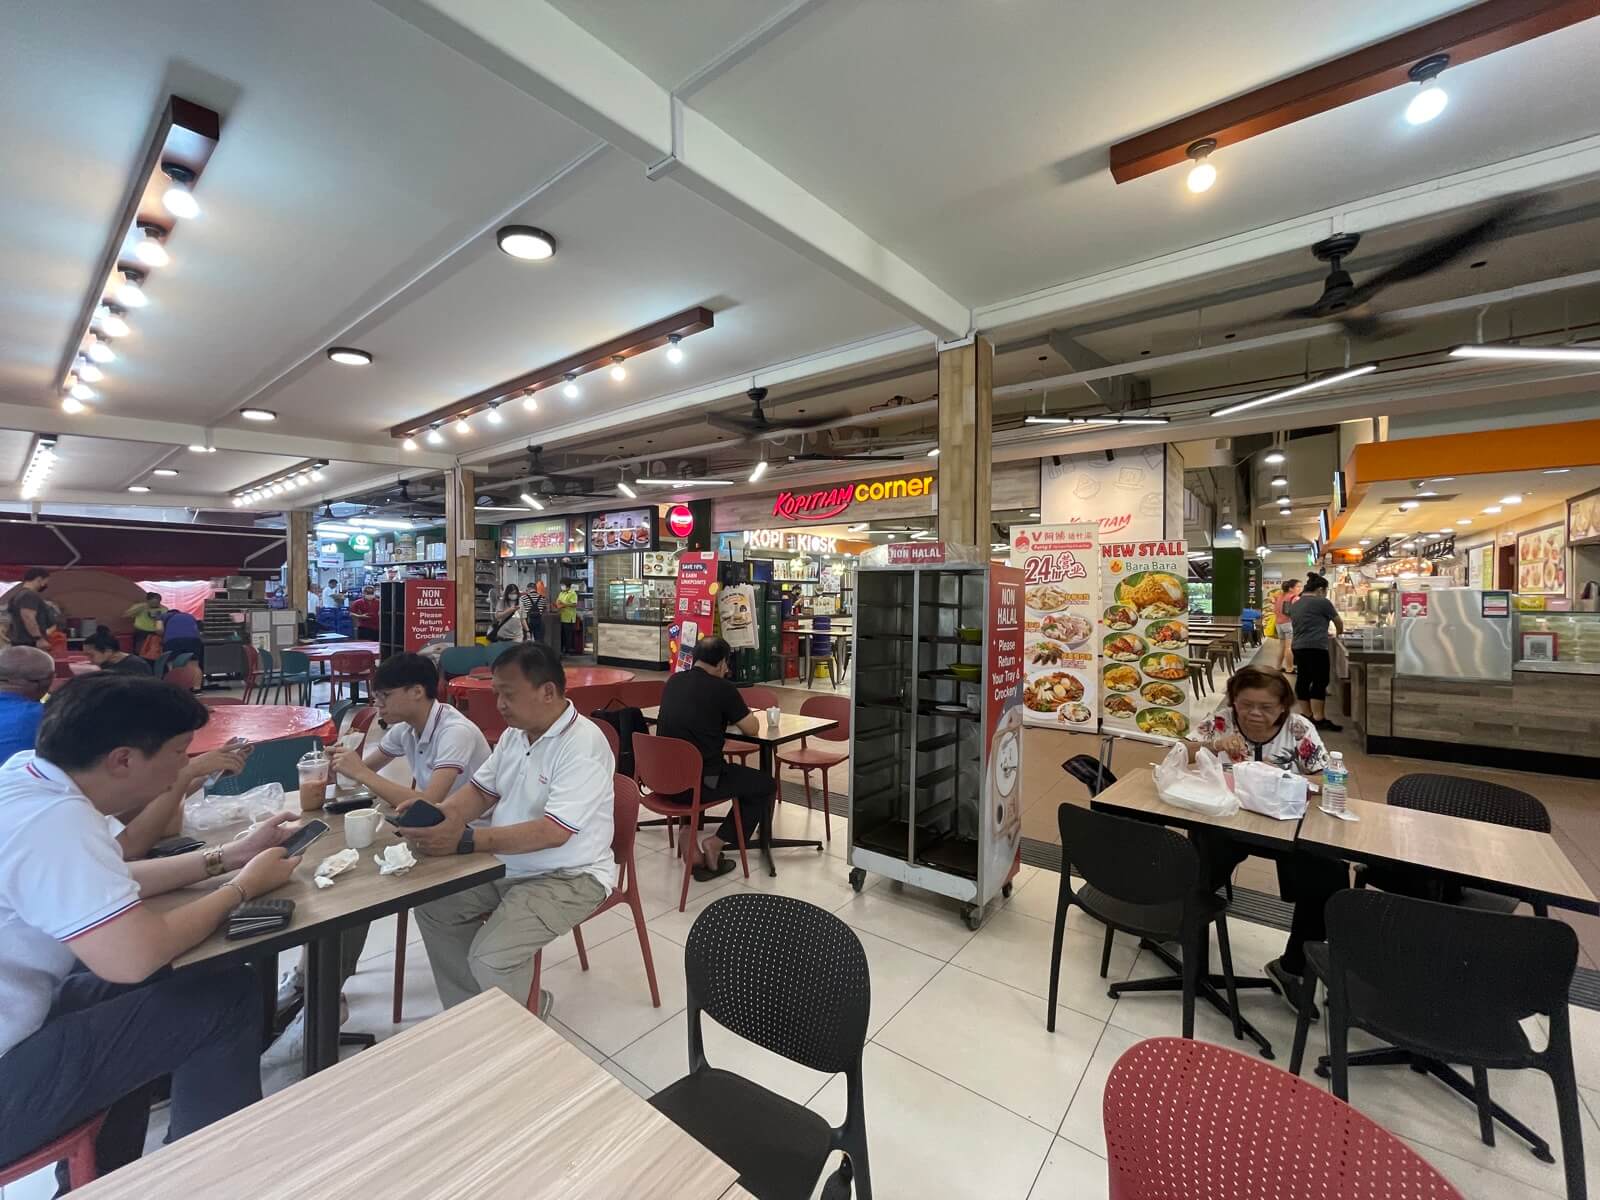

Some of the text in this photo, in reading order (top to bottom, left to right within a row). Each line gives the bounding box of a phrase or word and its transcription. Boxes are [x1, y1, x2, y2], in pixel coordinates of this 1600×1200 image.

[855, 476, 934, 503] corner
[749, 529, 785, 551] KOPI
[797, 535, 838, 556] KIOSK
[890, 547, 943, 559] NON HALAL
[1102, 544, 1136, 558] NEW
[1138, 542, 1184, 557] STALL
[1126, 561, 1177, 571] Bara Bara
[422, 589, 441, 598] NON
[1002, 588, 1016, 606] NON
[417, 598, 445, 607] HALAL
[997, 607, 1018, 625] HALAL
[429, 625, 443, 633] Tray
[998, 639, 1016, 652] Please
[998, 655, 1016, 668] Return
[992, 667, 1021, 685] Your Tray &
[994, 685, 1018, 701] Crockery
